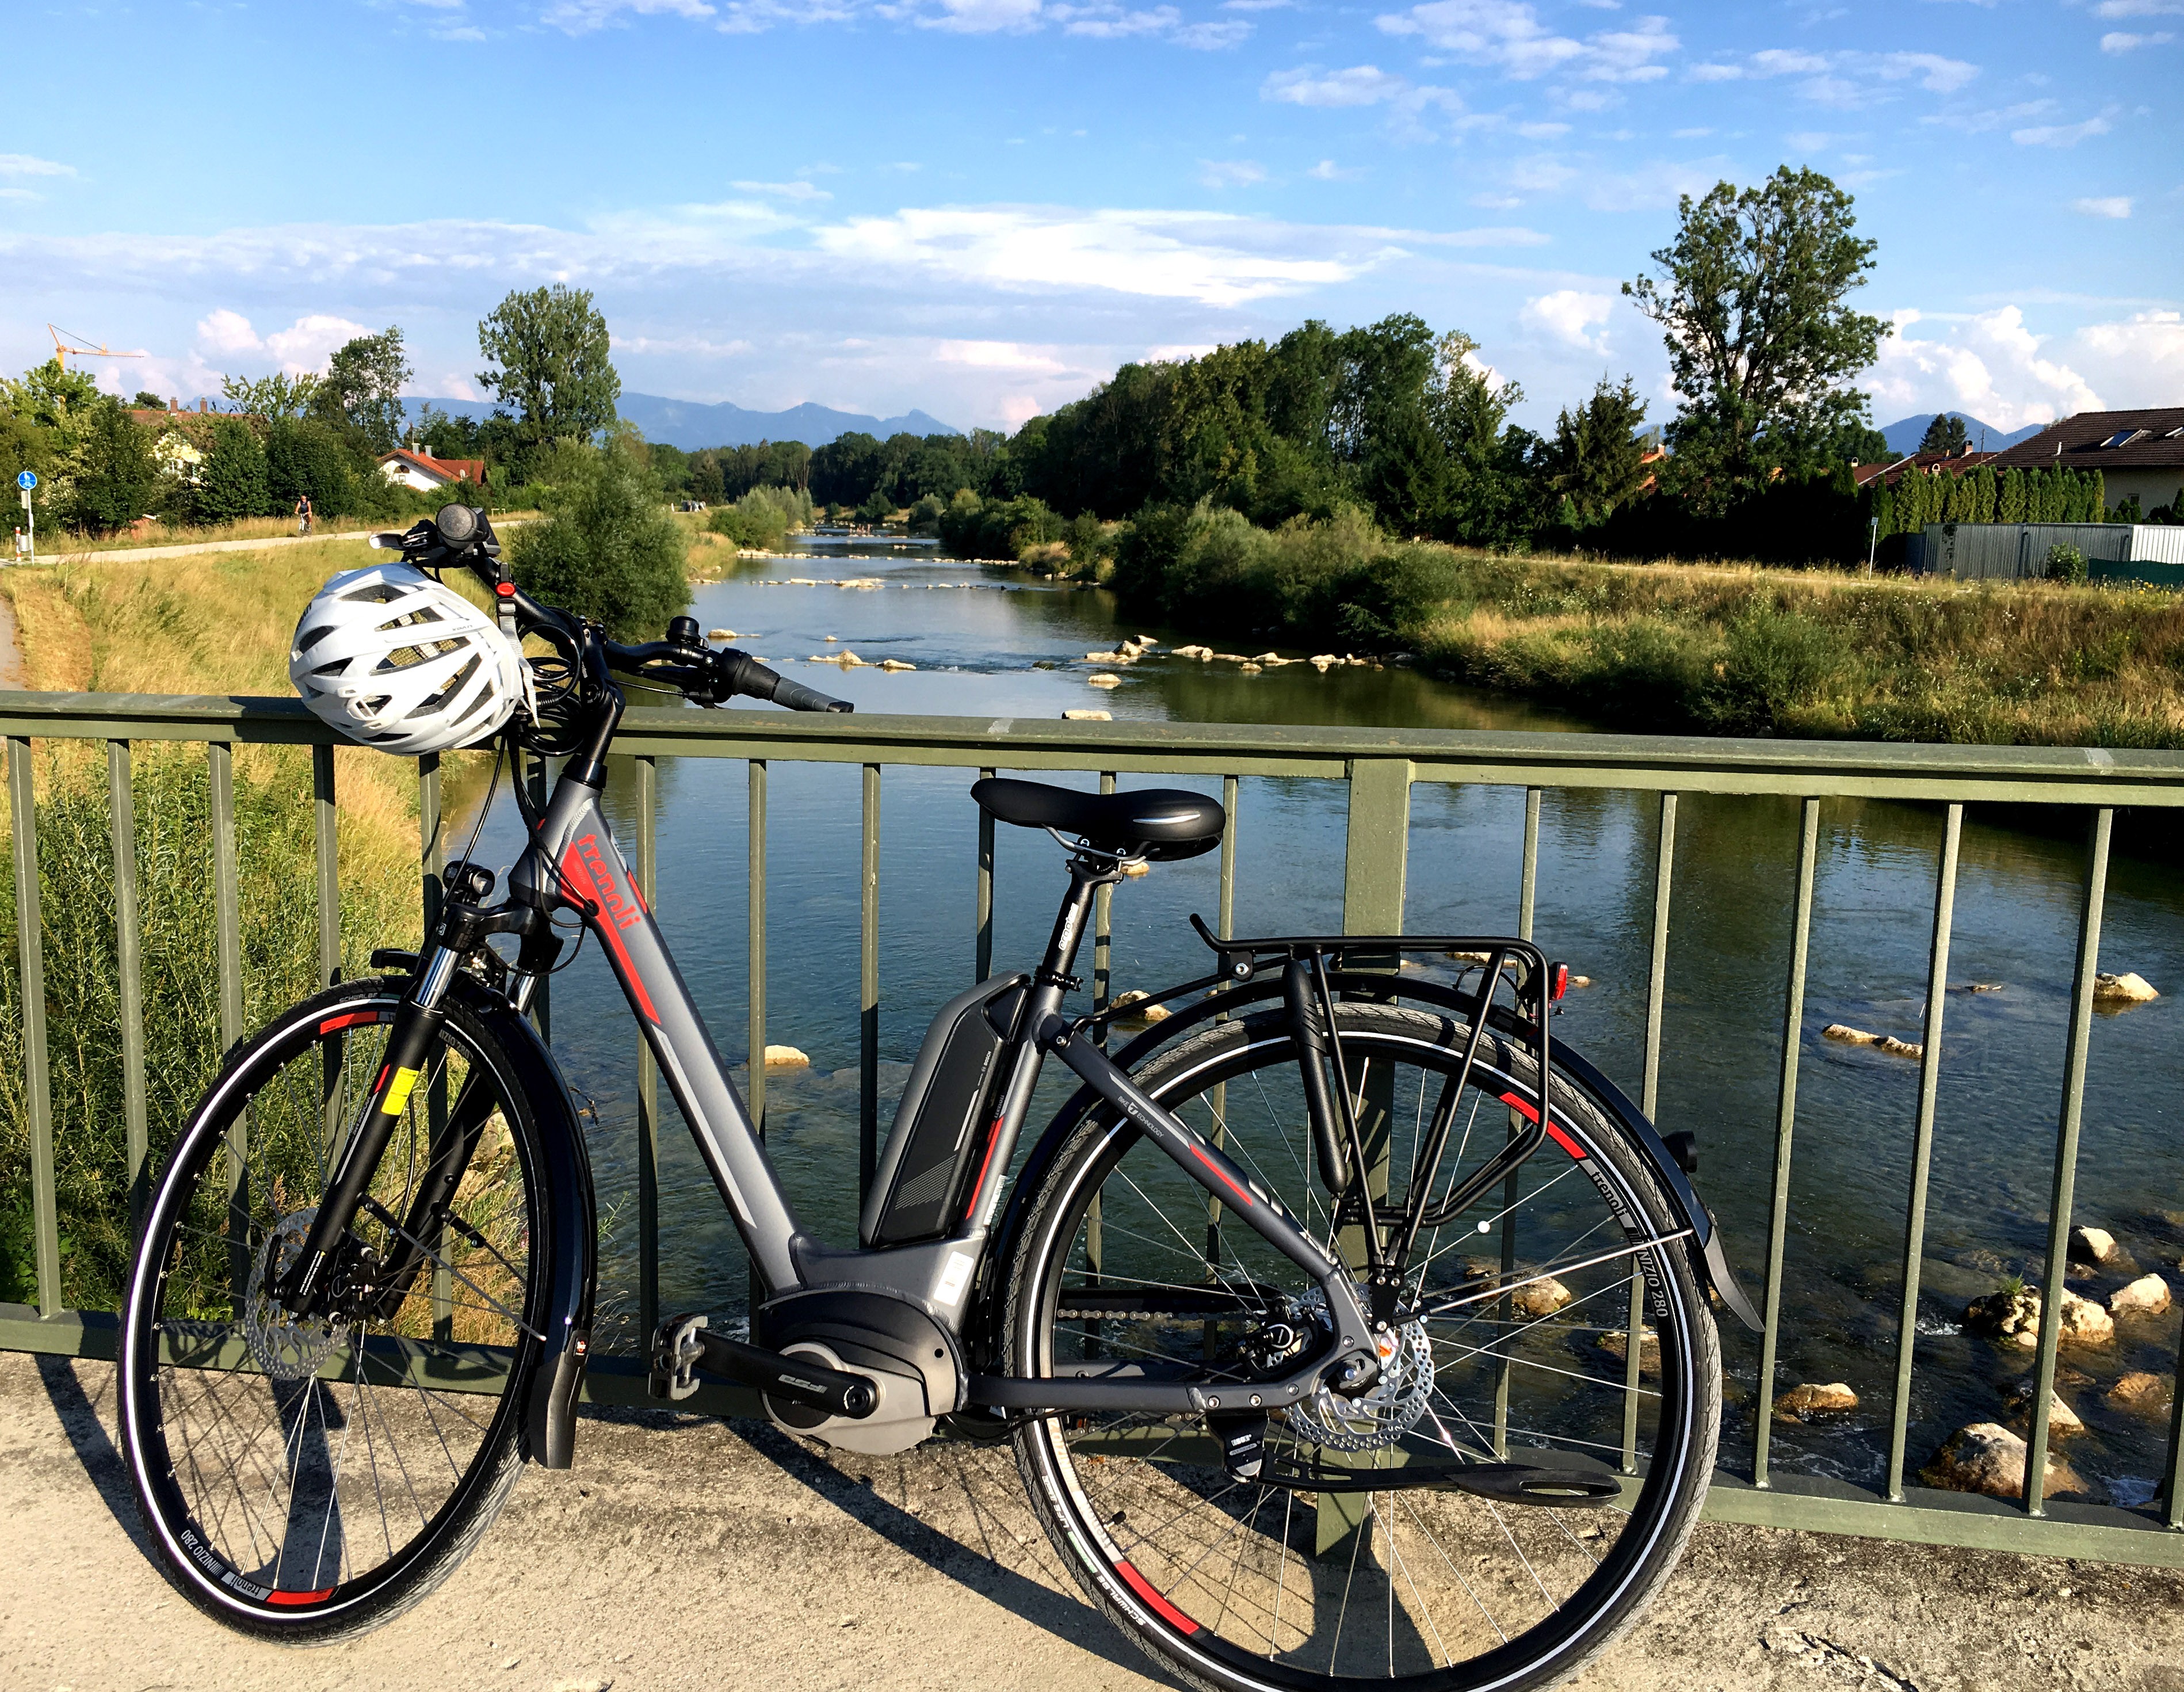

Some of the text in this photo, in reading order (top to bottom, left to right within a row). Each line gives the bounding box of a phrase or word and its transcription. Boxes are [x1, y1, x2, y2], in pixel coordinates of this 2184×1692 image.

[578, 833, 642, 930] trenoli
[339, 992, 378, 1004] SCHWALBE
[456, 1041, 470, 1060] 280
[1117, 1096, 1130, 1107] BIKE
[1591, 1171, 1628, 1217] trenoli
[1651, 1291, 1668, 1317] 280
[1053, 1504, 1069, 1529] LIFE
[181, 1529, 198, 1550] 280
[230, 1574, 261, 1596] trenoli
[1096, 1576, 1146, 1626] SCHWALBE
